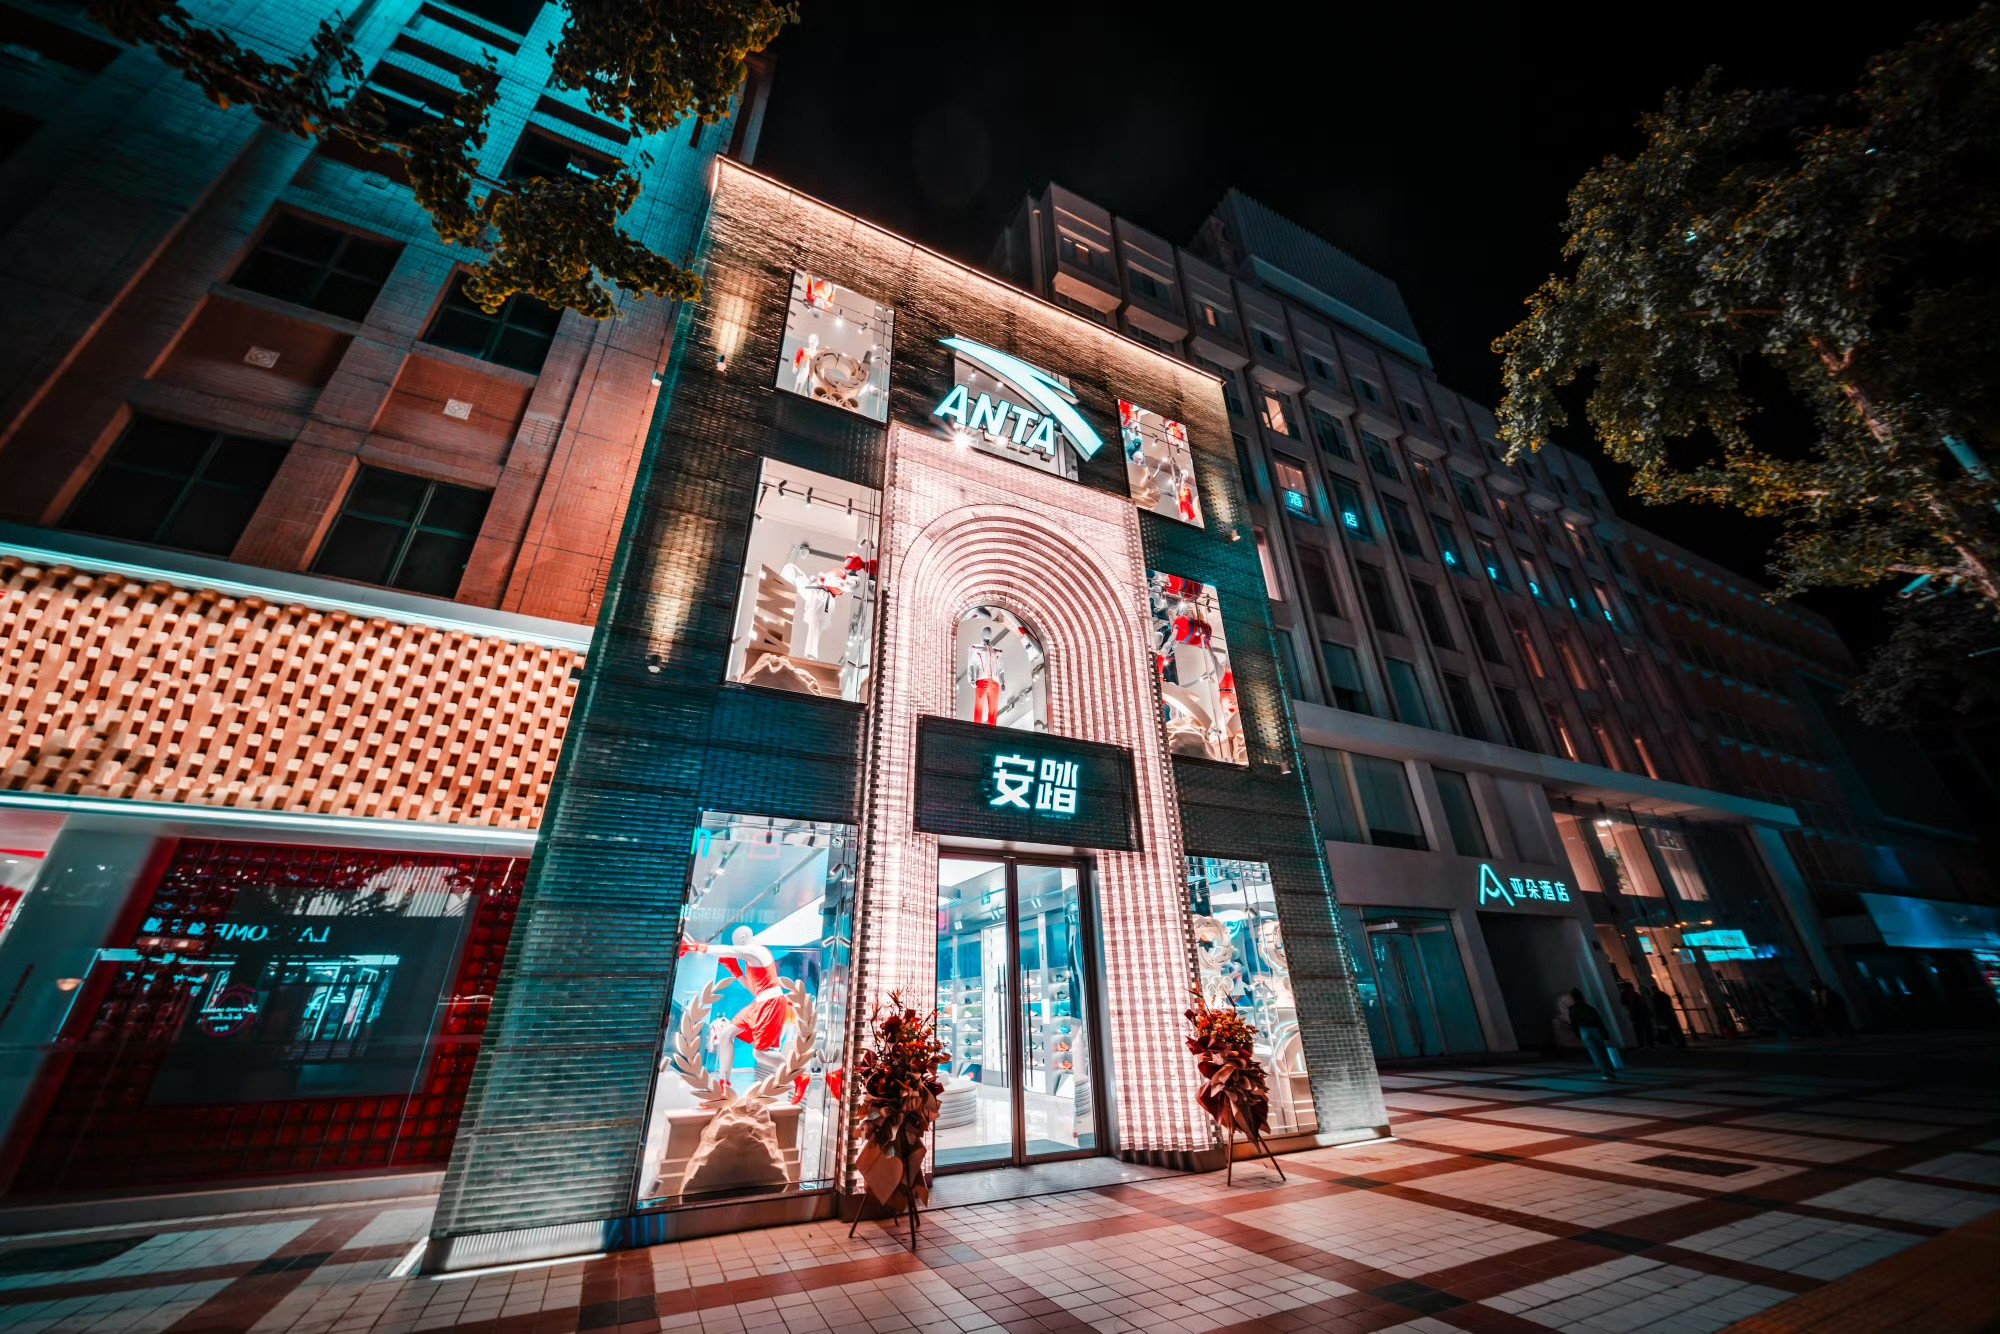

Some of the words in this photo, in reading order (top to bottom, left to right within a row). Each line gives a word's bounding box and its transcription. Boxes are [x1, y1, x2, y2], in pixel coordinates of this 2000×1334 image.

[933, 383, 1056, 456] ANTA
[989, 753, 1080, 814] 安踏
[1508, 877, 1571, 902] 亚朵酒店
